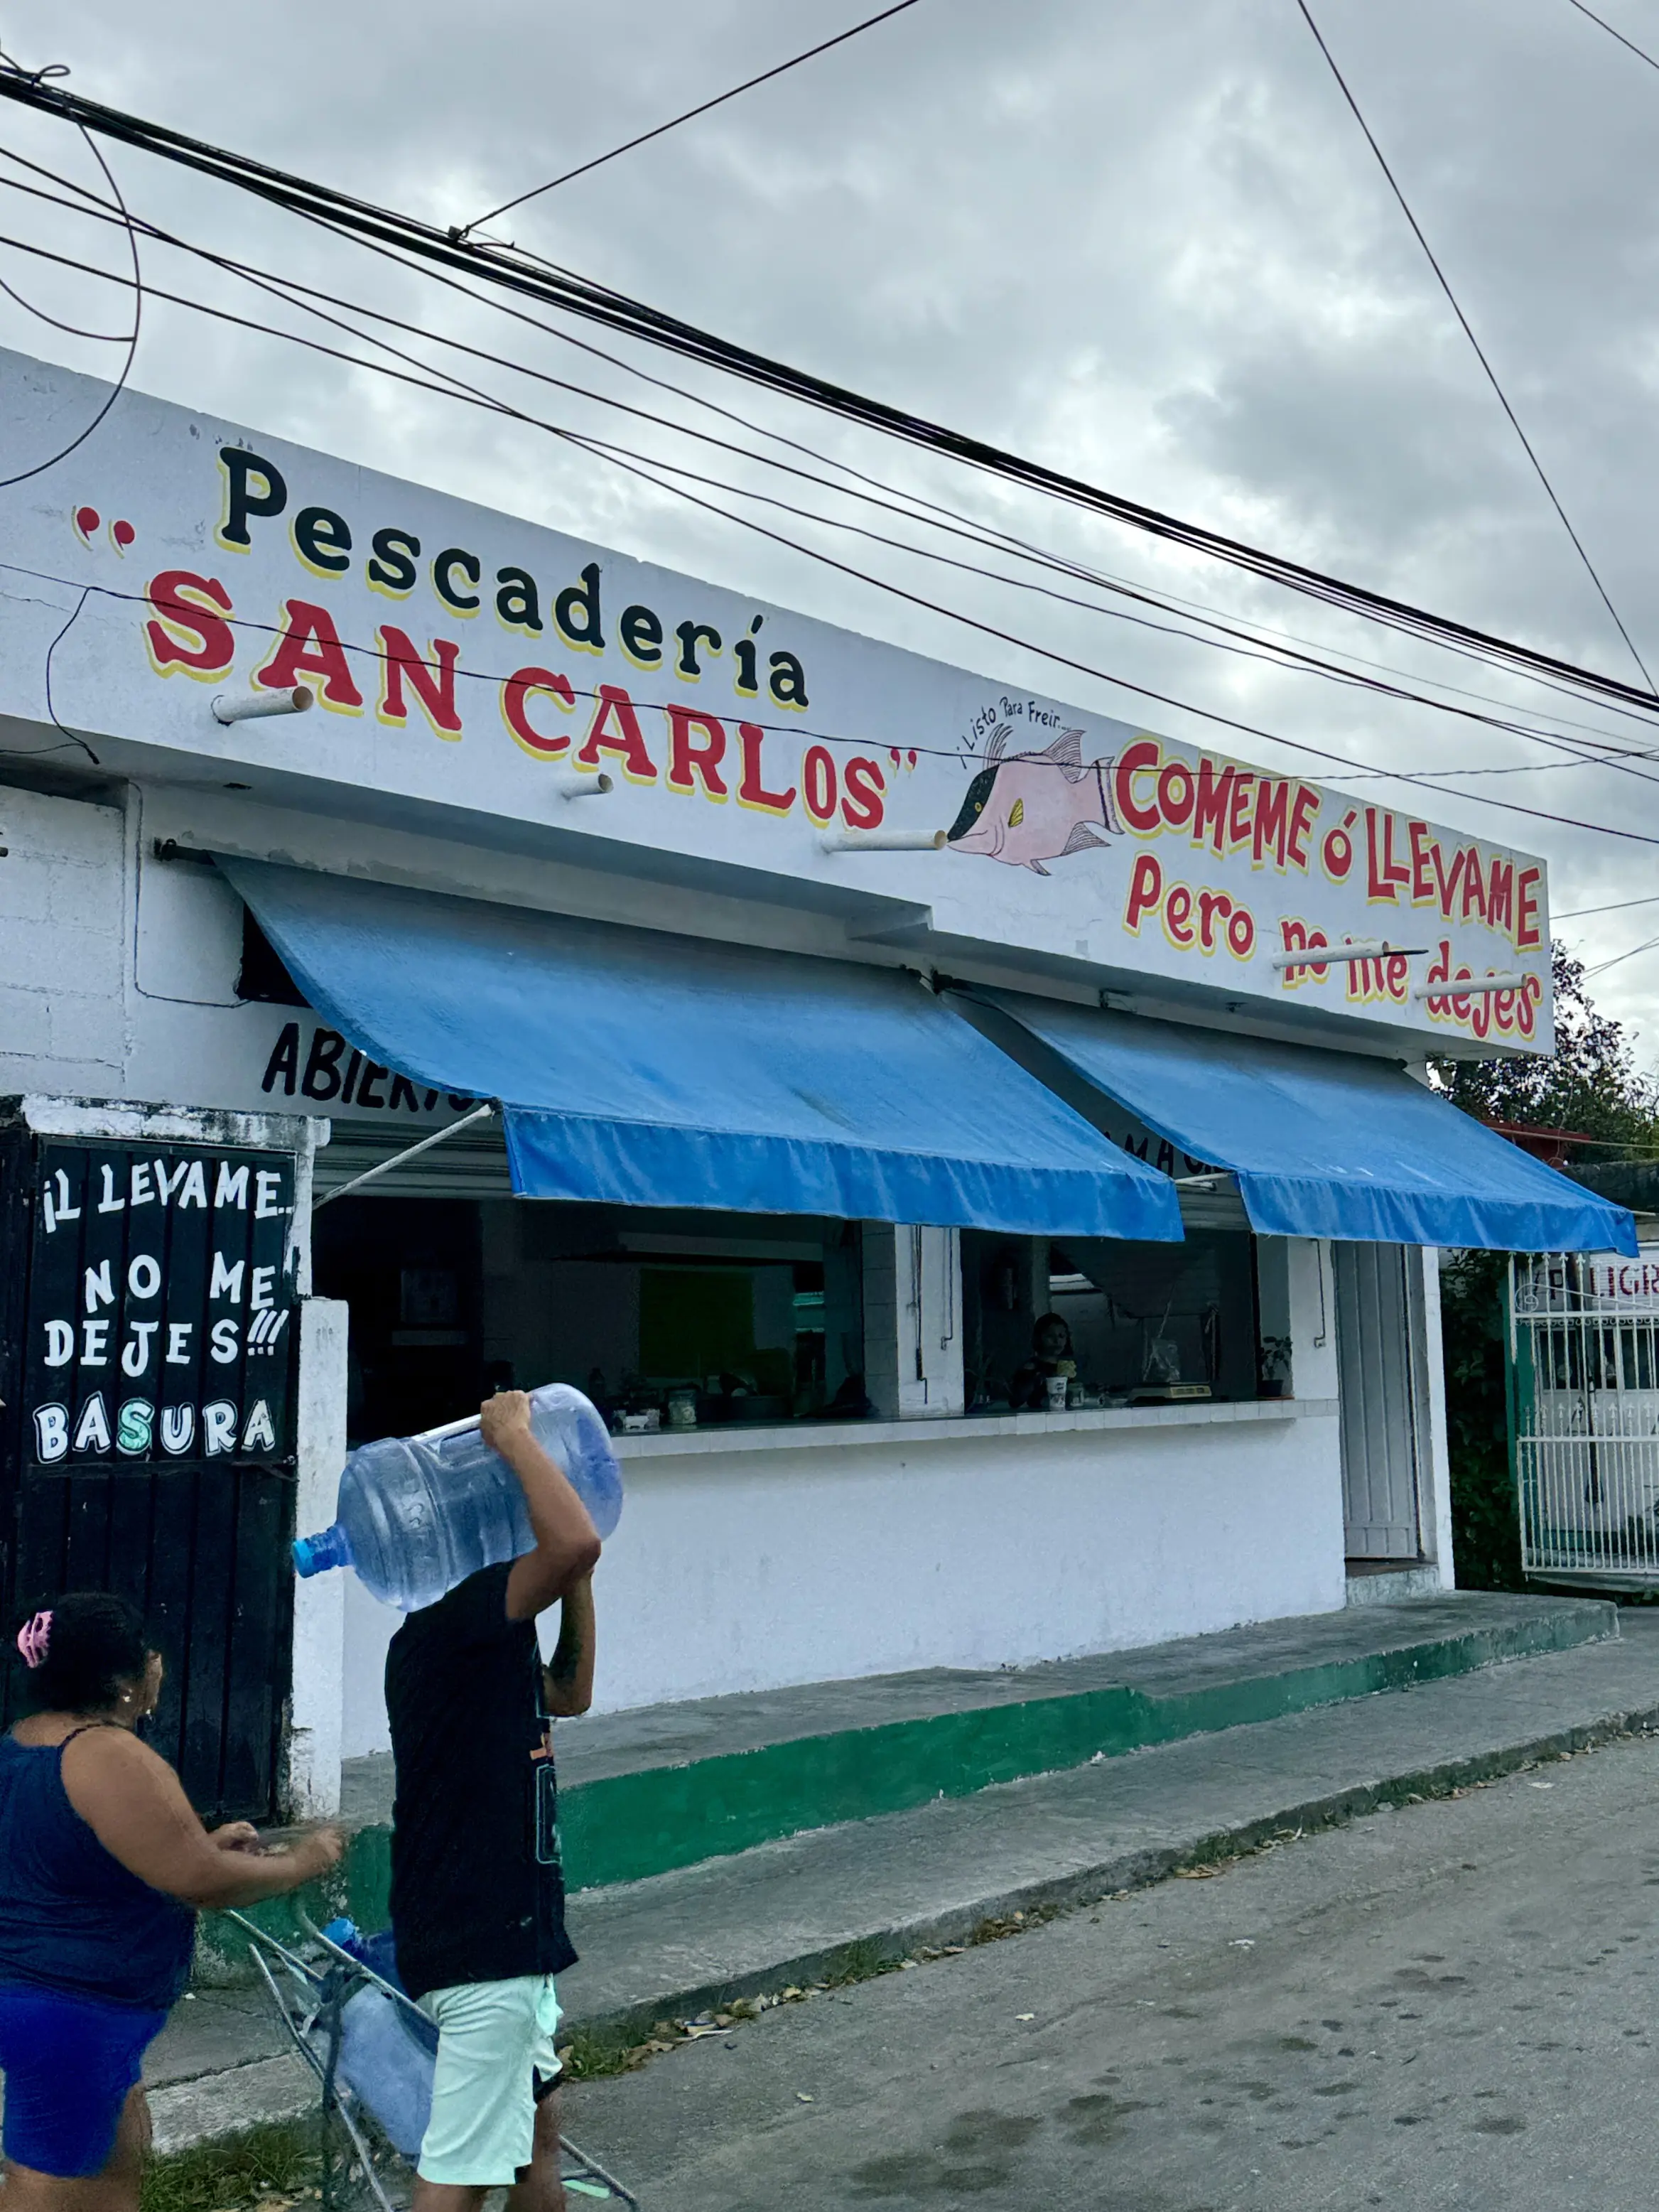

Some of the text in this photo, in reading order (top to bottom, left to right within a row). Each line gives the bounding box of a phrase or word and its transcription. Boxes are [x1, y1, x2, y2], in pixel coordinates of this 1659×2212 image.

[215, 446, 809, 713] Pescadería
[999, 696, 1023, 718] Para
[1114, 738, 1322, 875] COMEME
[1363, 806, 1542, 953] LLEVAME
[1124, 852, 1256, 959] Pero
[1279, 917, 1331, 988] no
[261, 1022, 476, 1113] ABIER
[85, 1251, 276, 1313] NO ME
[44, 1309, 289, 1377] DEJES!!!
[33, 1391, 276, 1464] BASURA
